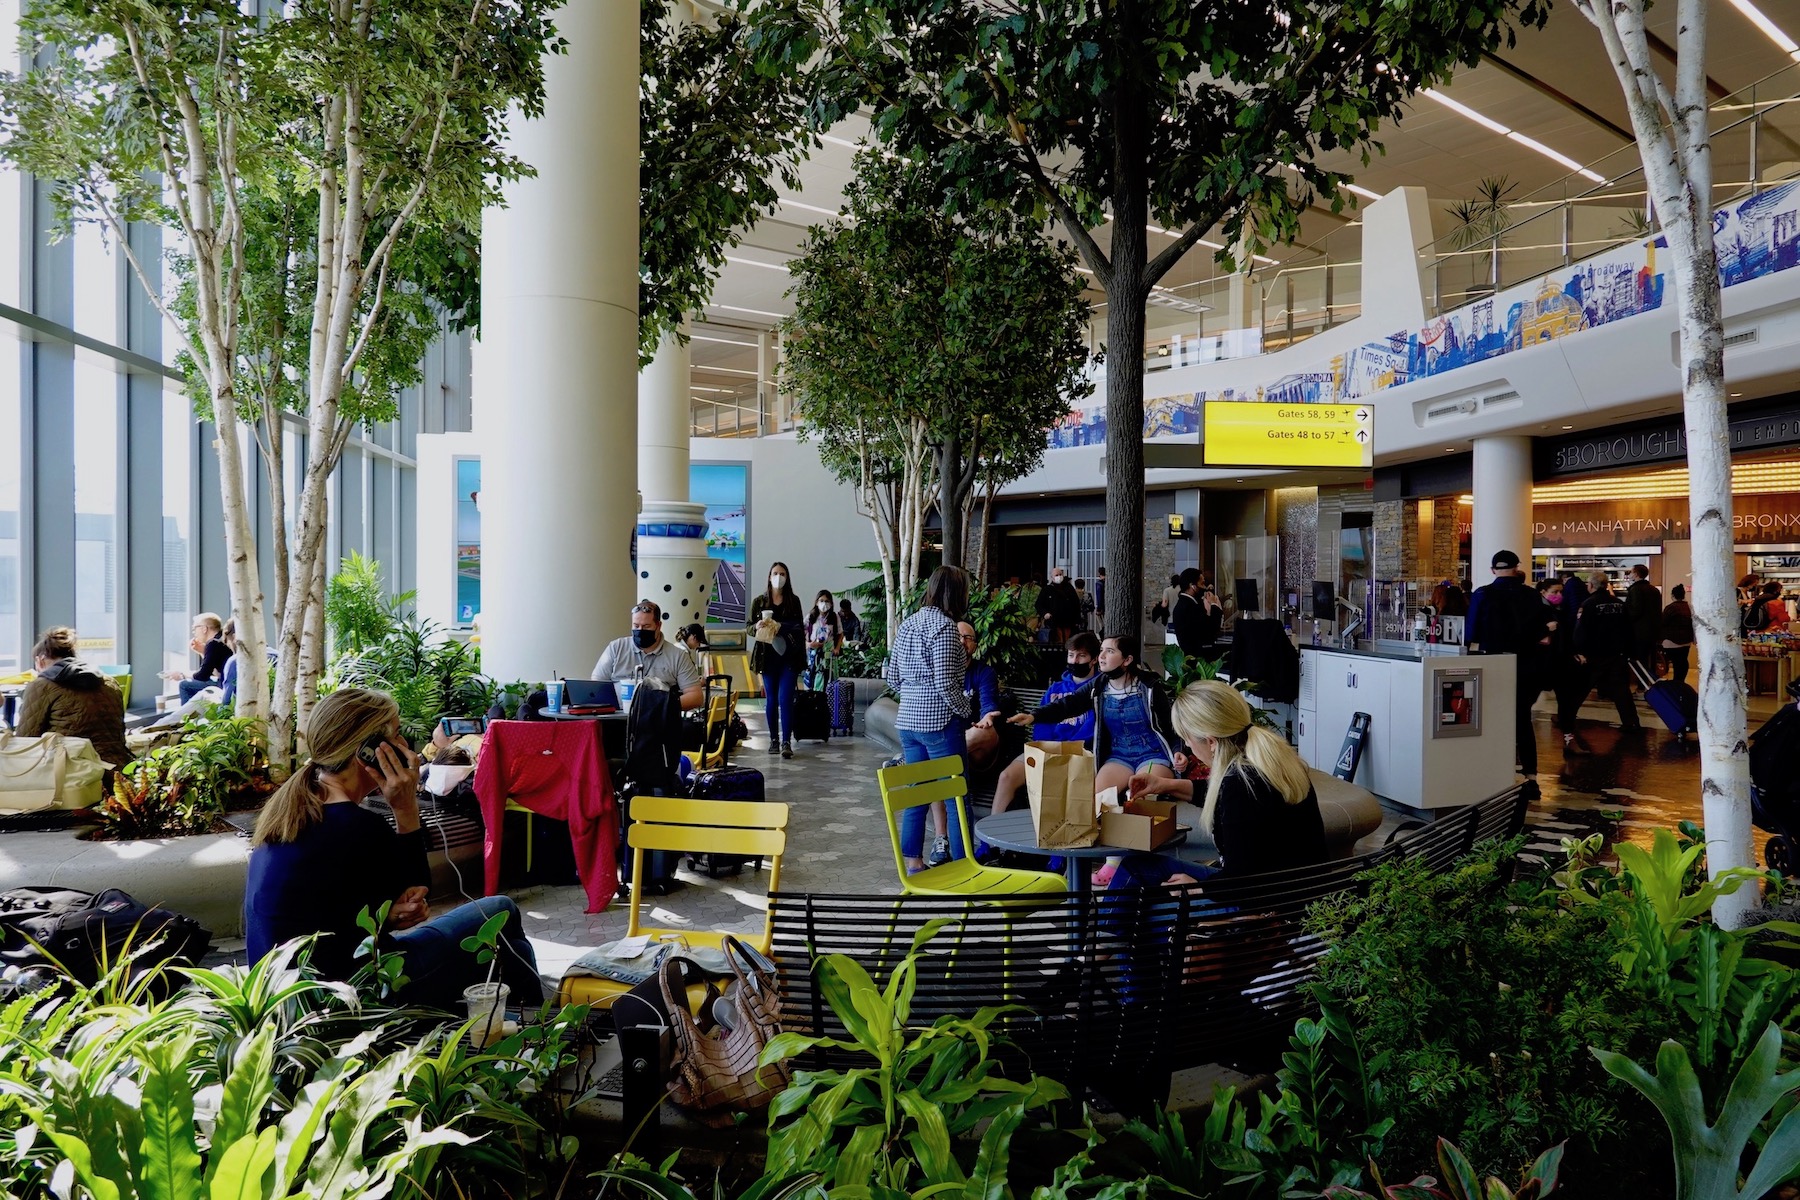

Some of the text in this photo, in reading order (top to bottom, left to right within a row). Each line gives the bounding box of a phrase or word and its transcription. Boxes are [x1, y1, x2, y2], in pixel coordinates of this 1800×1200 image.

[1593, 262, 1635, 277] roadway
[1360, 347, 1383, 365] Times
[1278, 409, 1336, 419] Gates 58, 59
[1267, 430, 1294, 439] Gates
[1297, 431, 1309, 439] 48
[1324, 431, 1335, 440] 57
[1563, 518, 1670, 534] MANHATTAN
[1733, 513, 1800, 528] BRONX
